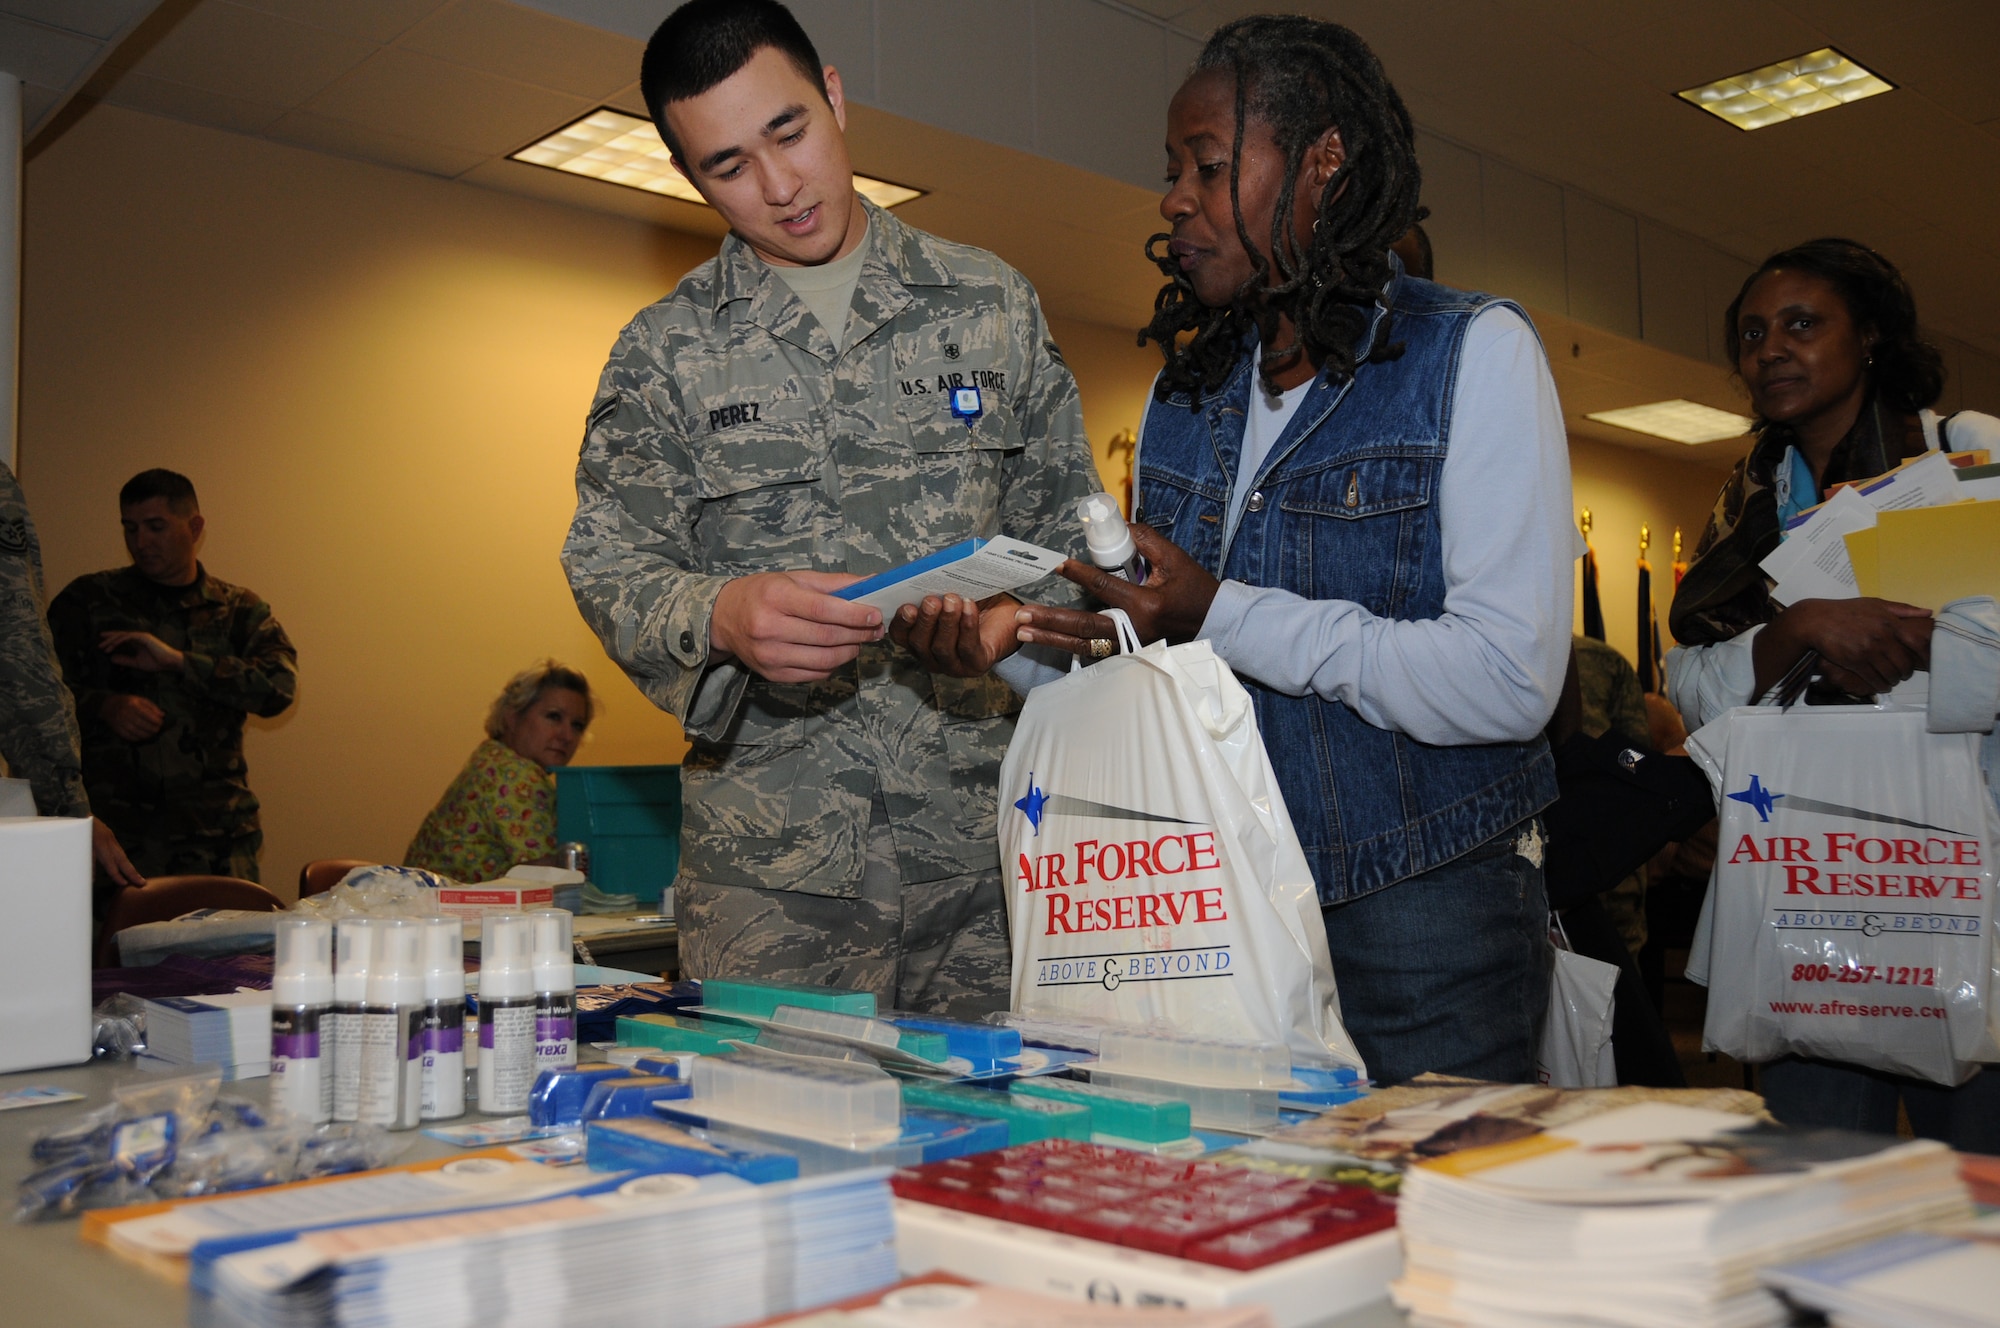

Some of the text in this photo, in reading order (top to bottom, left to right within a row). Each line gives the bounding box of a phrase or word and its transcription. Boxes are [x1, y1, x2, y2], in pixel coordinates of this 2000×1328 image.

[901, 370, 1006, 396] U.S. AIR FORCE
[709, 402, 761, 431] PEREZ
[1074, 831, 1221, 886] FORCE
[1727, 832, 1982, 866] AIR FORCE
[1782, 865, 1982, 900] RESERVE
[1044, 887, 1228, 936] RESERVE
[1777, 913, 1981, 937] ABOVE & BEOND
[1038, 951, 1231, 991] ABOVE & BEYOND
[1791, 963, 1935, 986] 800-257-1212
[536, 1007, 552, 1015] and
